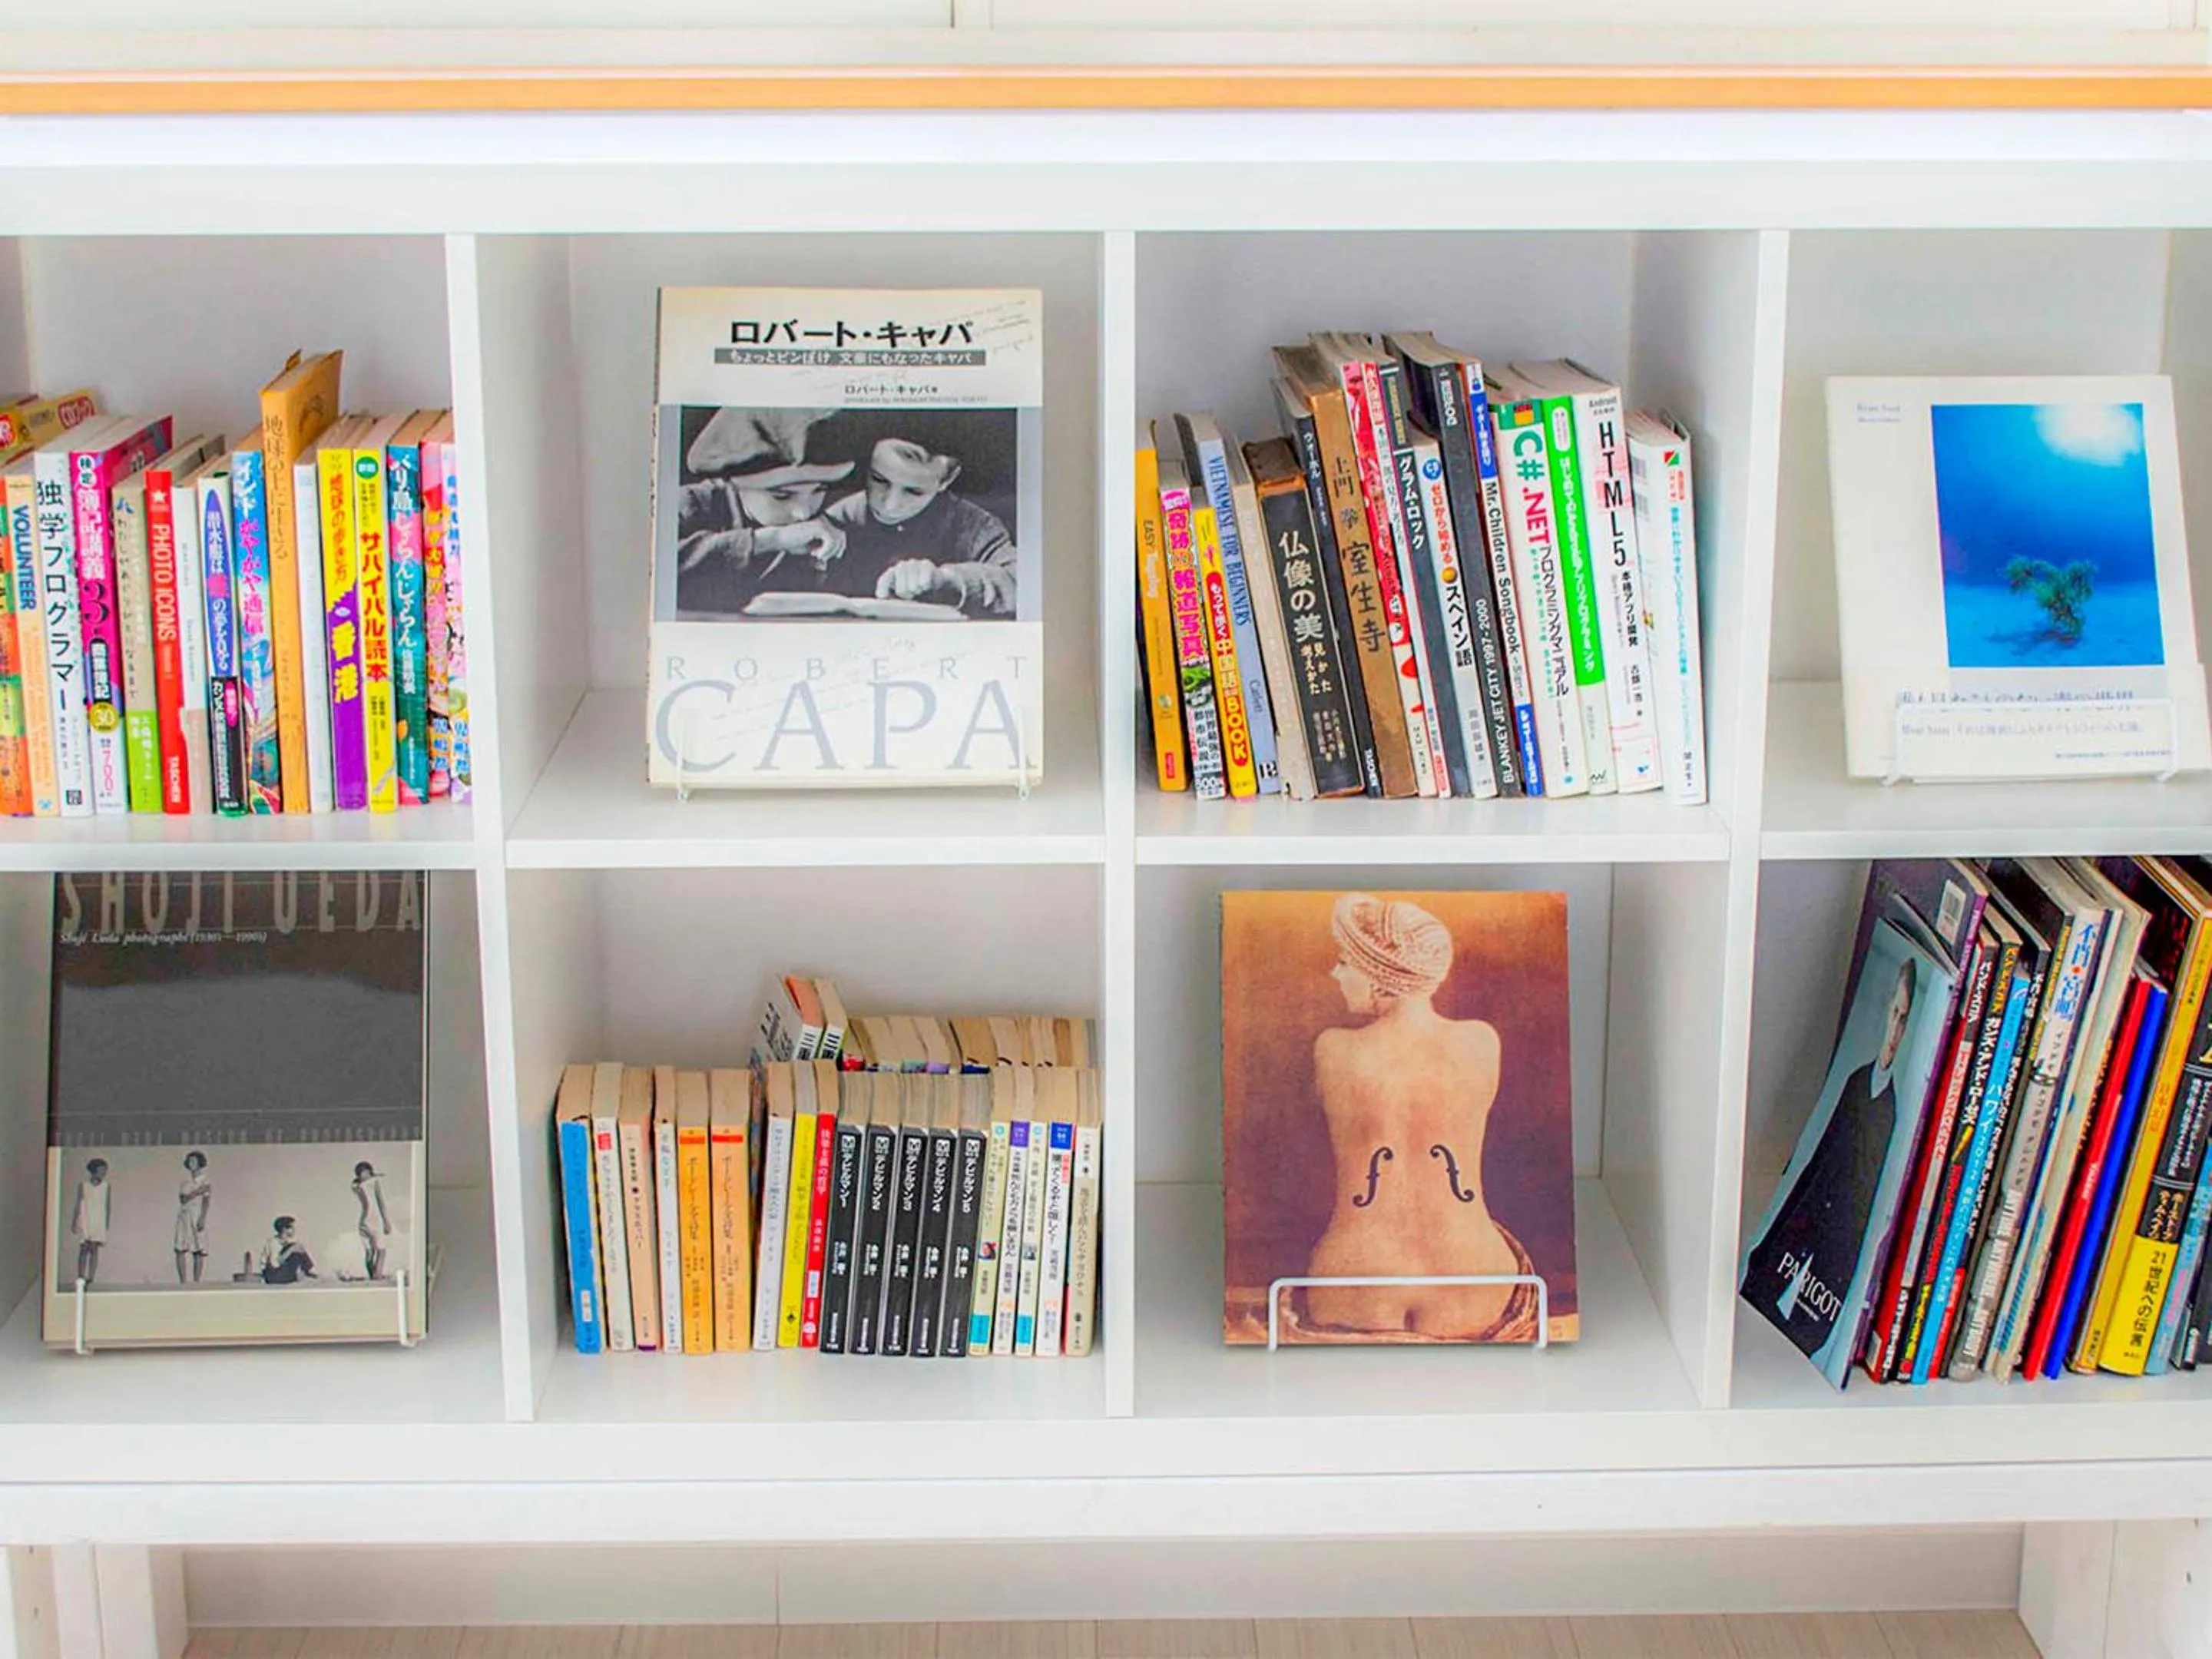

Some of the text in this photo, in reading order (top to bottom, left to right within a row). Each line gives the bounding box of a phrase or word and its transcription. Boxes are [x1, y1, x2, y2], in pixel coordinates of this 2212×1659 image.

[731, 320, 974, 347] ロバート・キャパ
[1208, 455, 1251, 627] VIETNAMESE FOR BEGINNERS
[1398, 454, 1426, 551] グラム・ロック
[1598, 421, 1627, 568] HTML5
[12, 503, 37, 611] VOLUNTEER
[37, 479, 75, 710] 独学プログラマー
[81, 579, 111, 624] 3
[153, 525, 177, 642] PHOTO ICONS
[1278, 530, 1325, 643] 仏像の美
[1341, 541, 1386, 652] 室生寺
[1485, 481, 1522, 654] Mr.Children Songbook
[360, 532, 389, 683] サバイバル読本
[1445, 584, 1472, 668] スペイン語
[666, 655, 1028, 680] ROBERT
[1490, 698, 1505, 722] JET
[655, 679, 1039, 773] CAPA
[1226, 698, 1249, 760] BOOK
[1495, 723, 1515, 784] BLANKEY
[168, 755, 182, 803] TASCHEN
[60, 873, 422, 935] SHOJI UEDA
[2129, 1250, 2167, 1348] 21世紀への伝言
